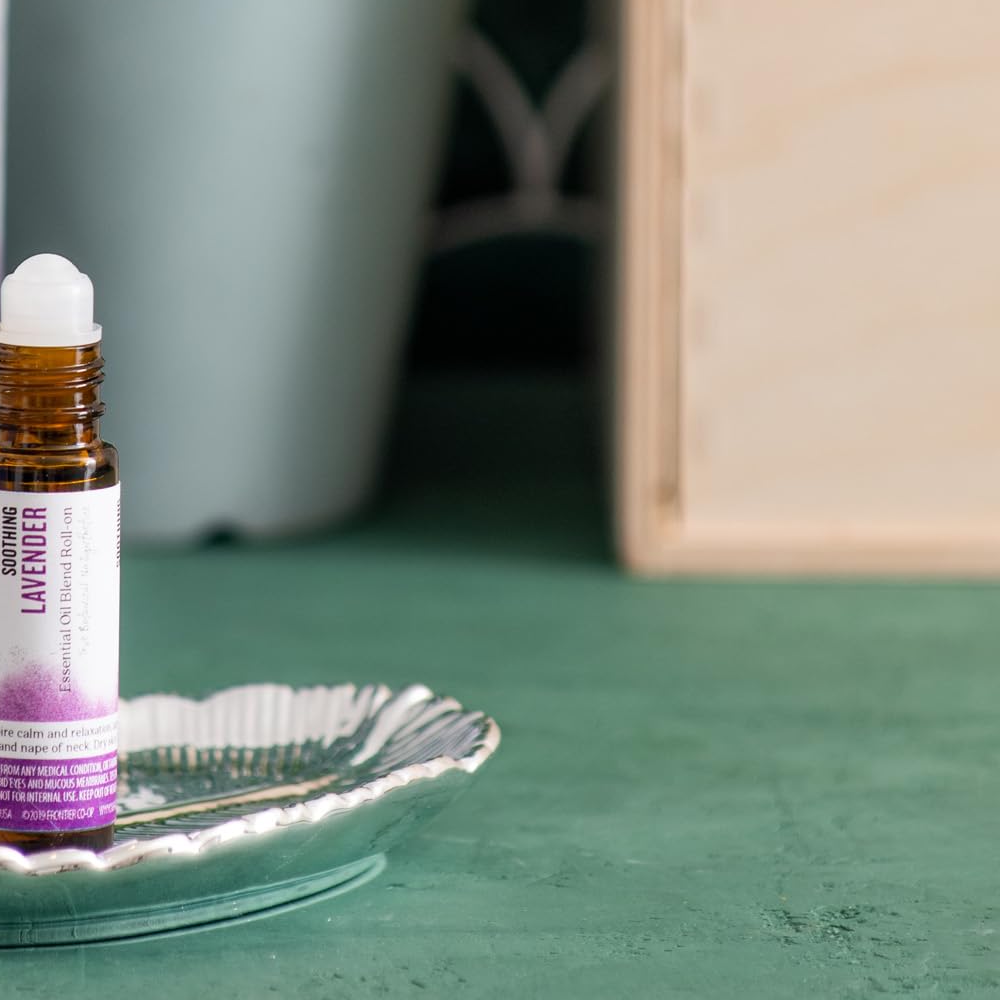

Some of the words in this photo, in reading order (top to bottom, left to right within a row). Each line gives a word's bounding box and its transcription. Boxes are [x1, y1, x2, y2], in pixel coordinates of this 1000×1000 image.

[1, 506, 18, 577] SOOTHING
[60, 507, 73, 559] Roll-on
[20, 507, 48, 614] LAVENDER
[60, 562, 72, 602] Blend
[59, 606, 72, 626] Oil
[59, 629, 72, 693] Essential
[16, 728, 44, 739] calm
[47, 727, 68, 739] and
[20, 744, 49, 756] nape
[51, 742, 64, 753] of
[0, 763, 20, 776] FROM
[21, 765, 36, 777] ANY
[37, 764, 68, 777] MEDICAL
[9, 777, 27, 789] EYES
[27, 778, 44, 790] AND
[44, 778, 76, 790] MUCOUS
[11, 791, 26, 802] FOR
[26, 791, 62, 803] INTERNAL
